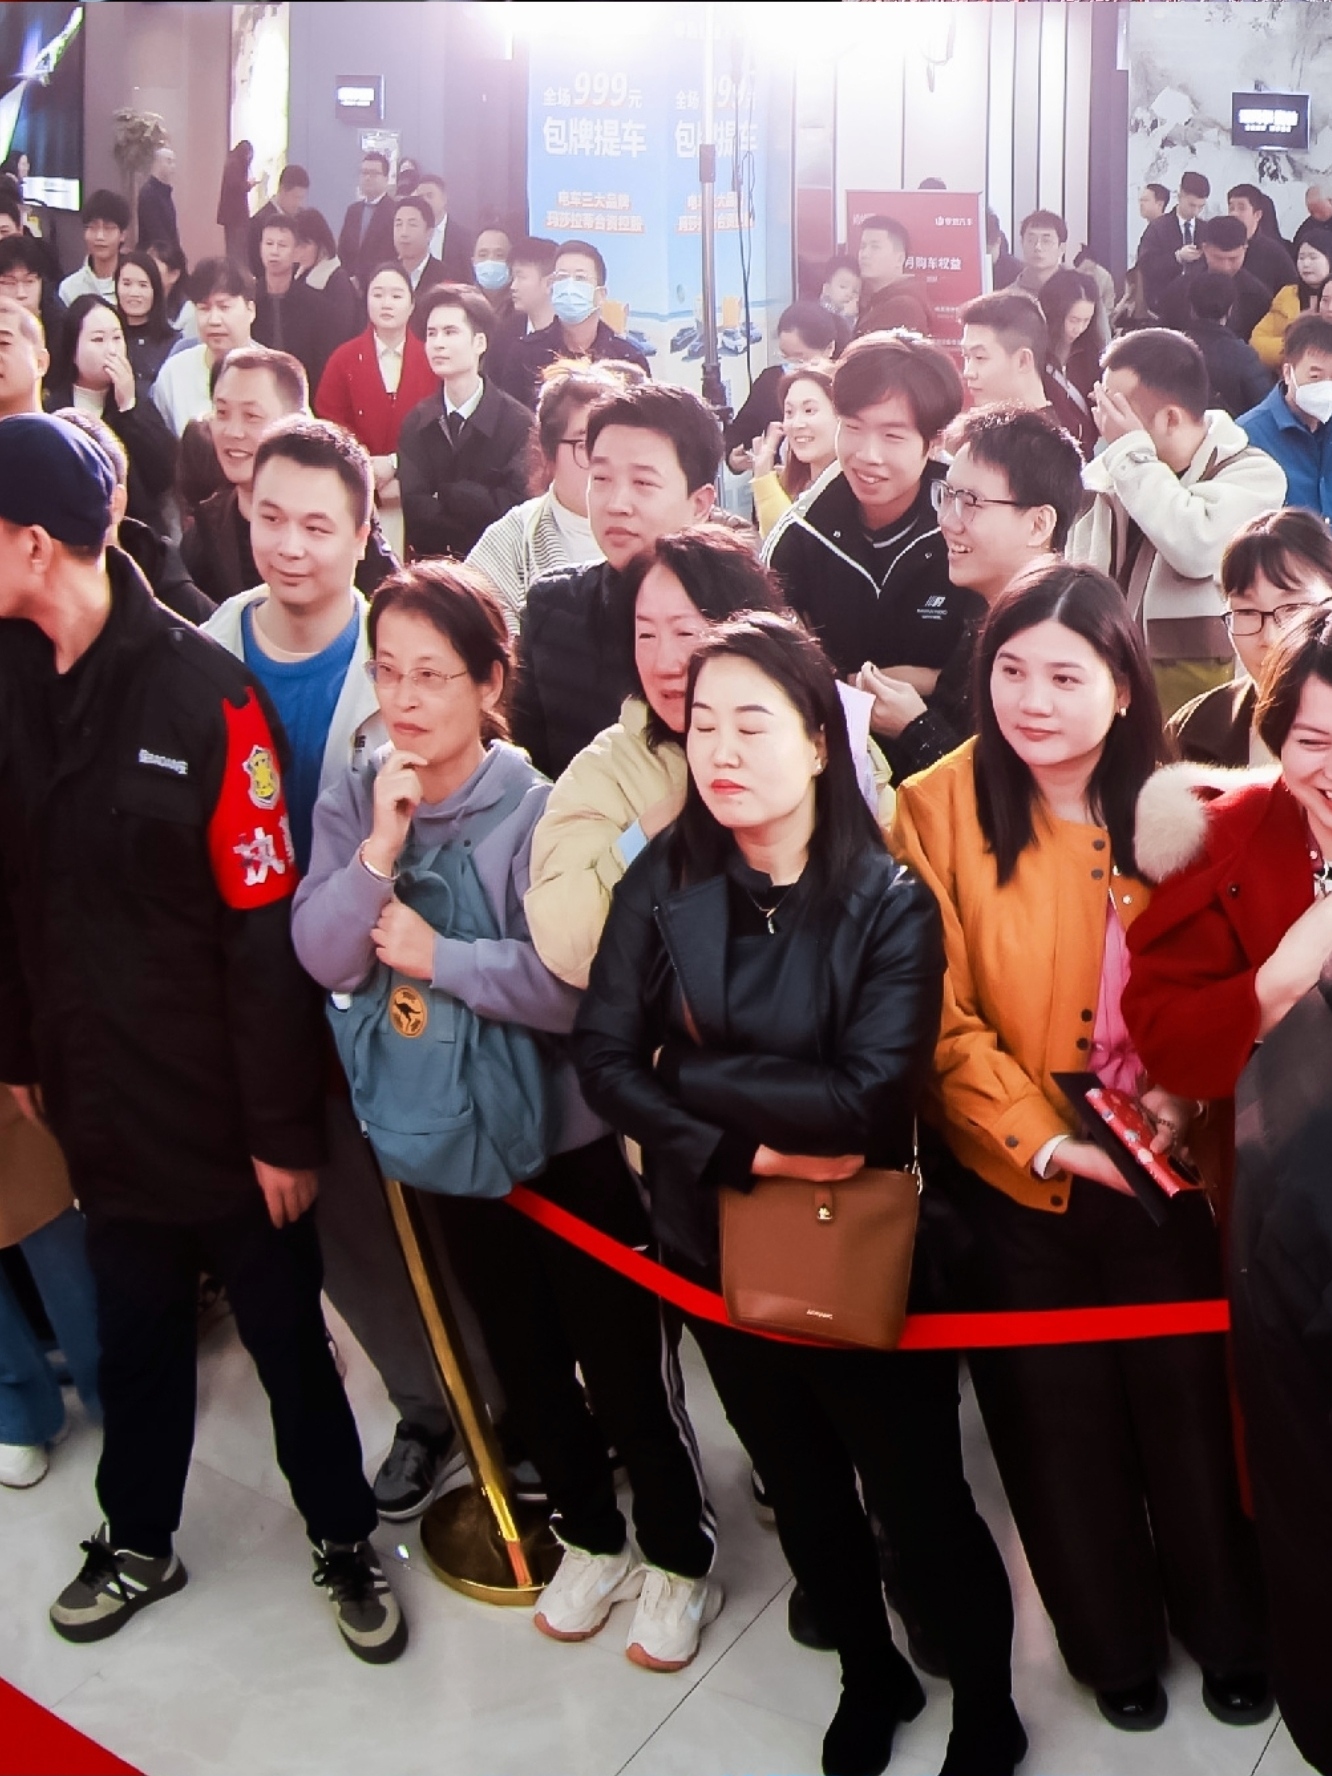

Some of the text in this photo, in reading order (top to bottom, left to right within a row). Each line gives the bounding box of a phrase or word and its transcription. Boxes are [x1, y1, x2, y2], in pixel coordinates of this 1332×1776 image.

[543, 73, 643, 110] 全场999元
[543, 116, 647, 159] 包牌提车
